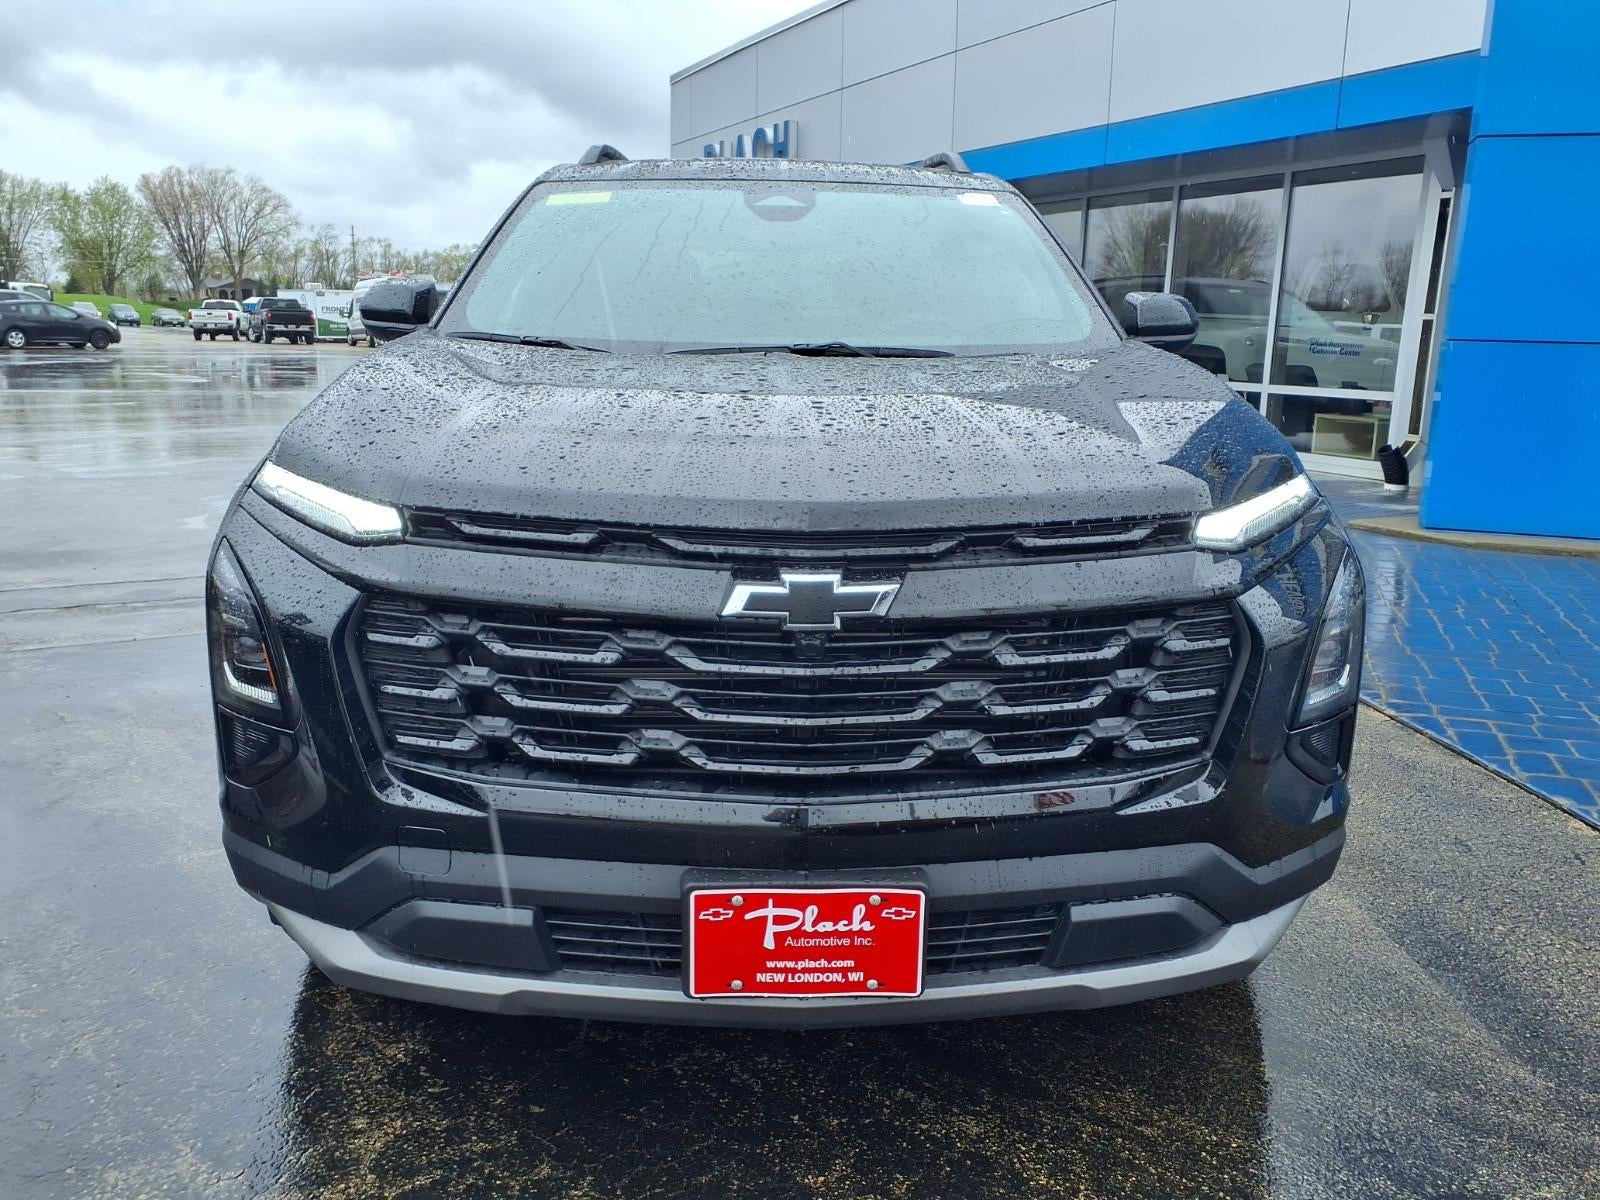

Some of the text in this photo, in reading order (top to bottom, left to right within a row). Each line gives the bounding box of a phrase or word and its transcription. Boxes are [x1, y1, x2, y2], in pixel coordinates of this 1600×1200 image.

[744, 898, 876, 950] Plach
[784, 936, 876, 947] Automotive Inc.
[766, 958, 855, 969] www.plach.com
[756, 972, 864, 984] NEW LONDON, WI
